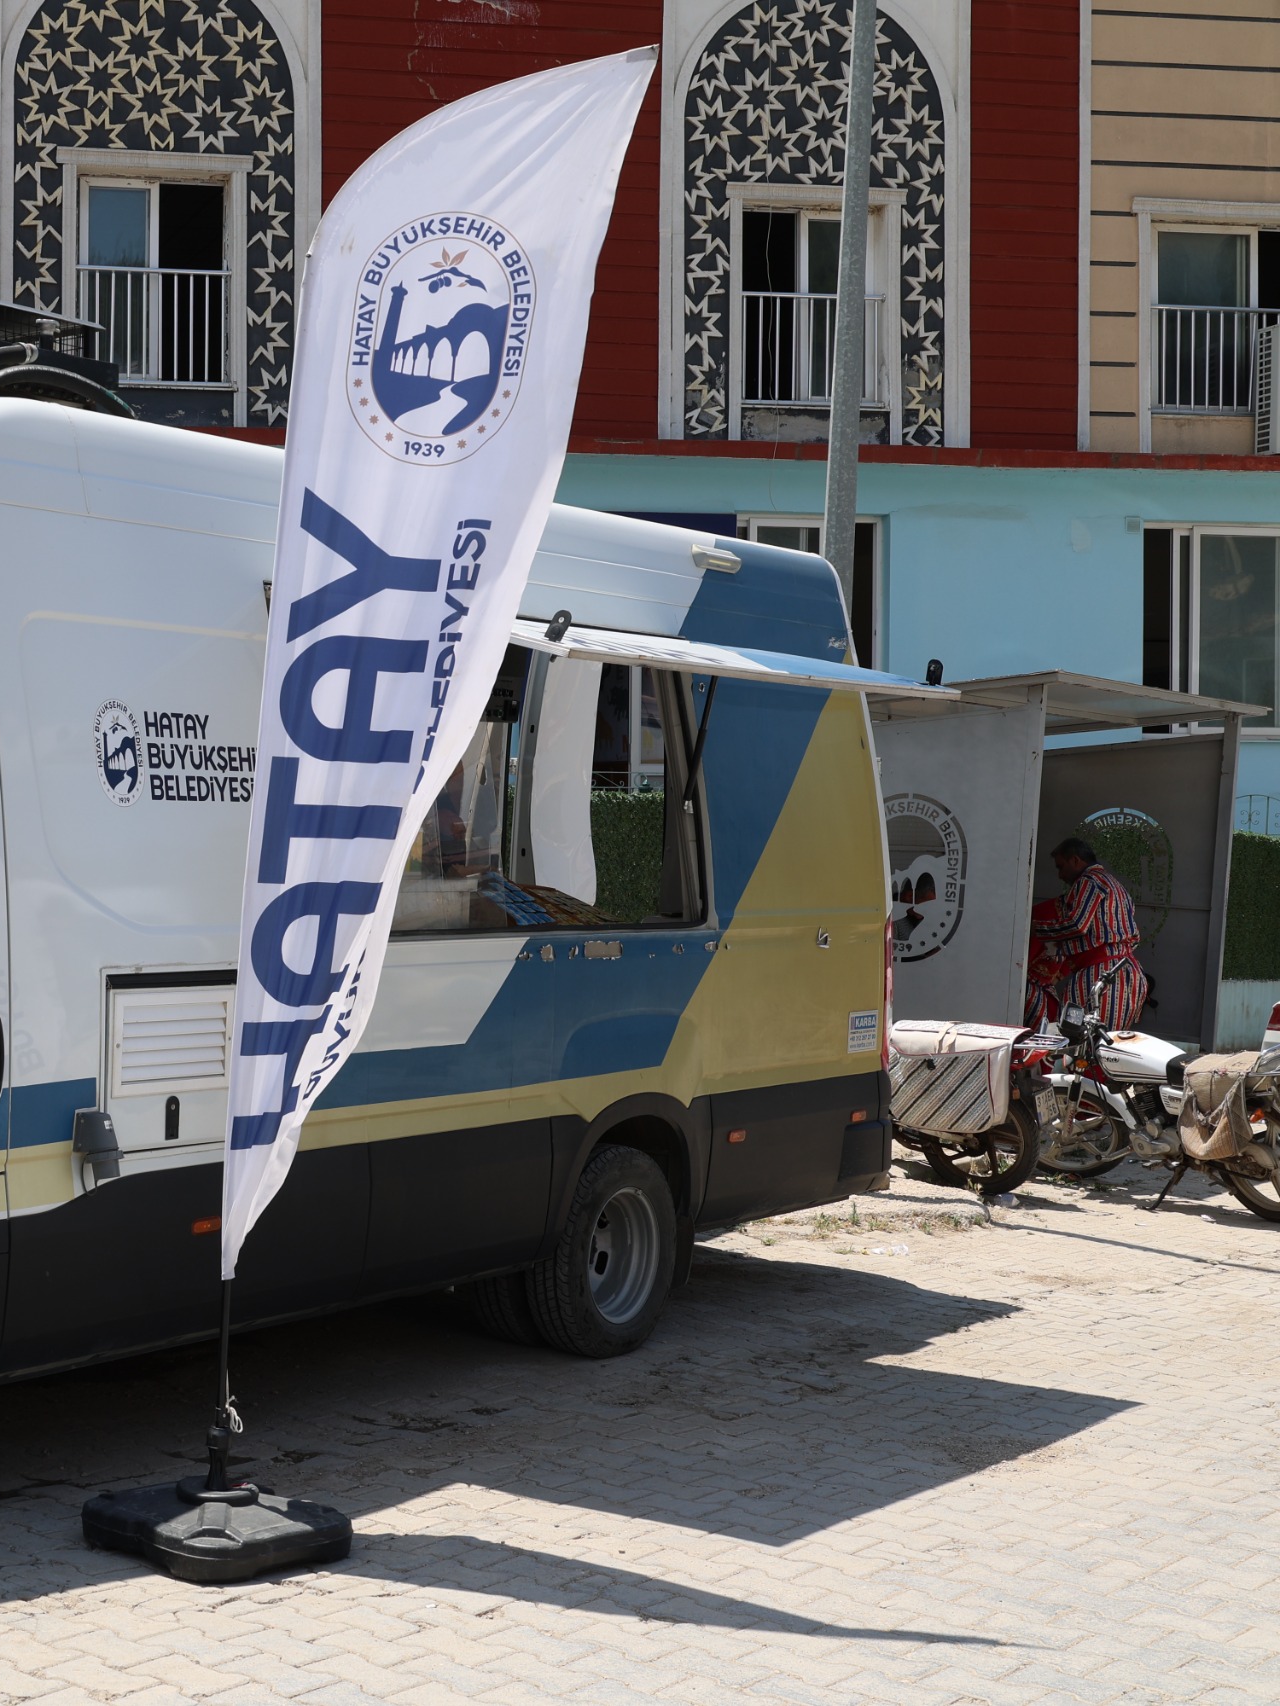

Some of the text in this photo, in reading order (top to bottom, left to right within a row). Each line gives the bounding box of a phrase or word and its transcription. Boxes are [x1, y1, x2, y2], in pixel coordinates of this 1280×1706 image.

[352, 216, 532, 377] HATAY BÜYÜKŞEHİR BELEDİYESİ
[404, 441, 445, 458] 1939
[144, 711, 209, 740] HATAY
[96, 737, 104, 768] HATAY
[147, 743, 258, 773] BÜYÜKŞEHİ
[230, 486, 442, 1151] HATAY
[885, 801, 940, 823] KŞEHİR
[855, 1016, 876, 1027] KARBA
